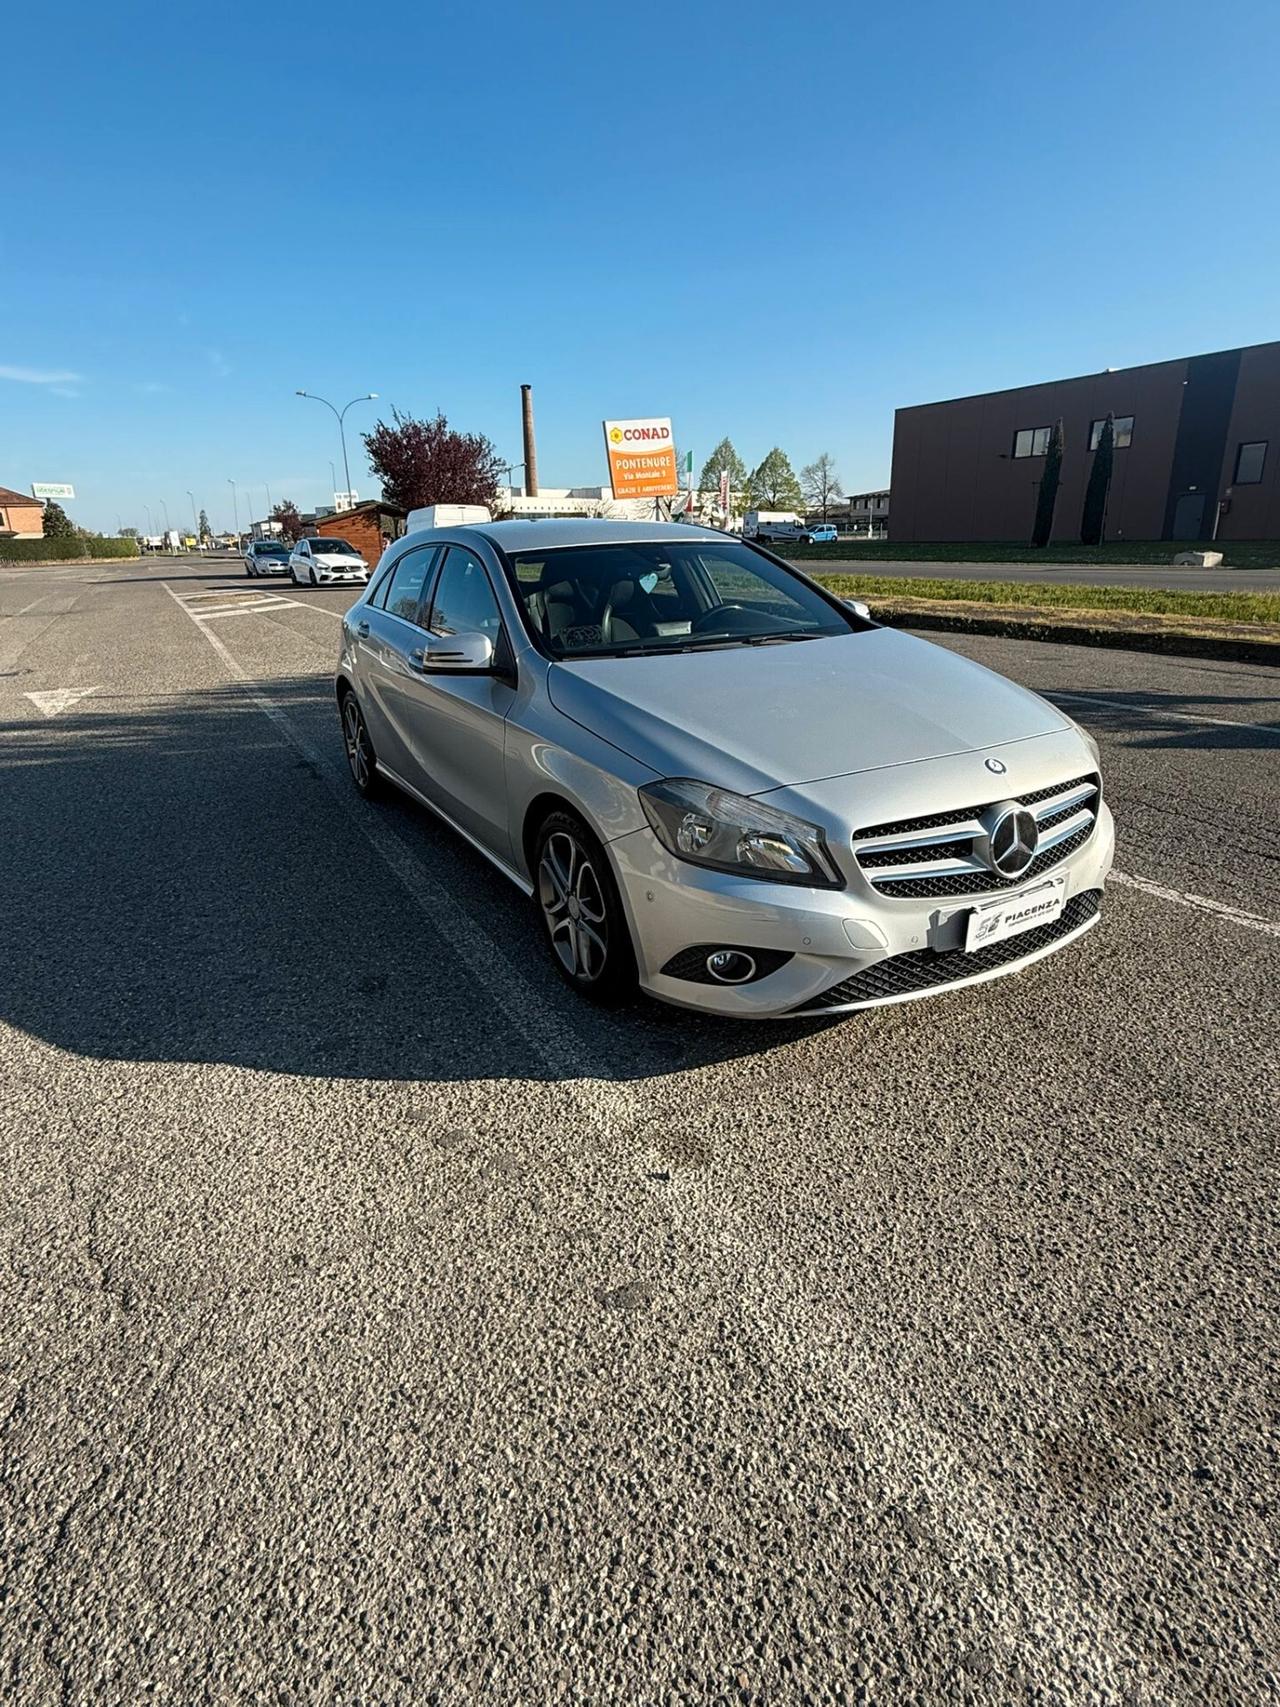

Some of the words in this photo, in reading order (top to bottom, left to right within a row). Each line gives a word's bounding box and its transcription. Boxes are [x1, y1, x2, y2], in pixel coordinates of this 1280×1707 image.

[624, 427, 669, 441] CONAD
[616, 456, 671, 470] PONTENURE
[624, 472, 634, 480] Via
[1005, 898, 1060, 924] PIACENZA
